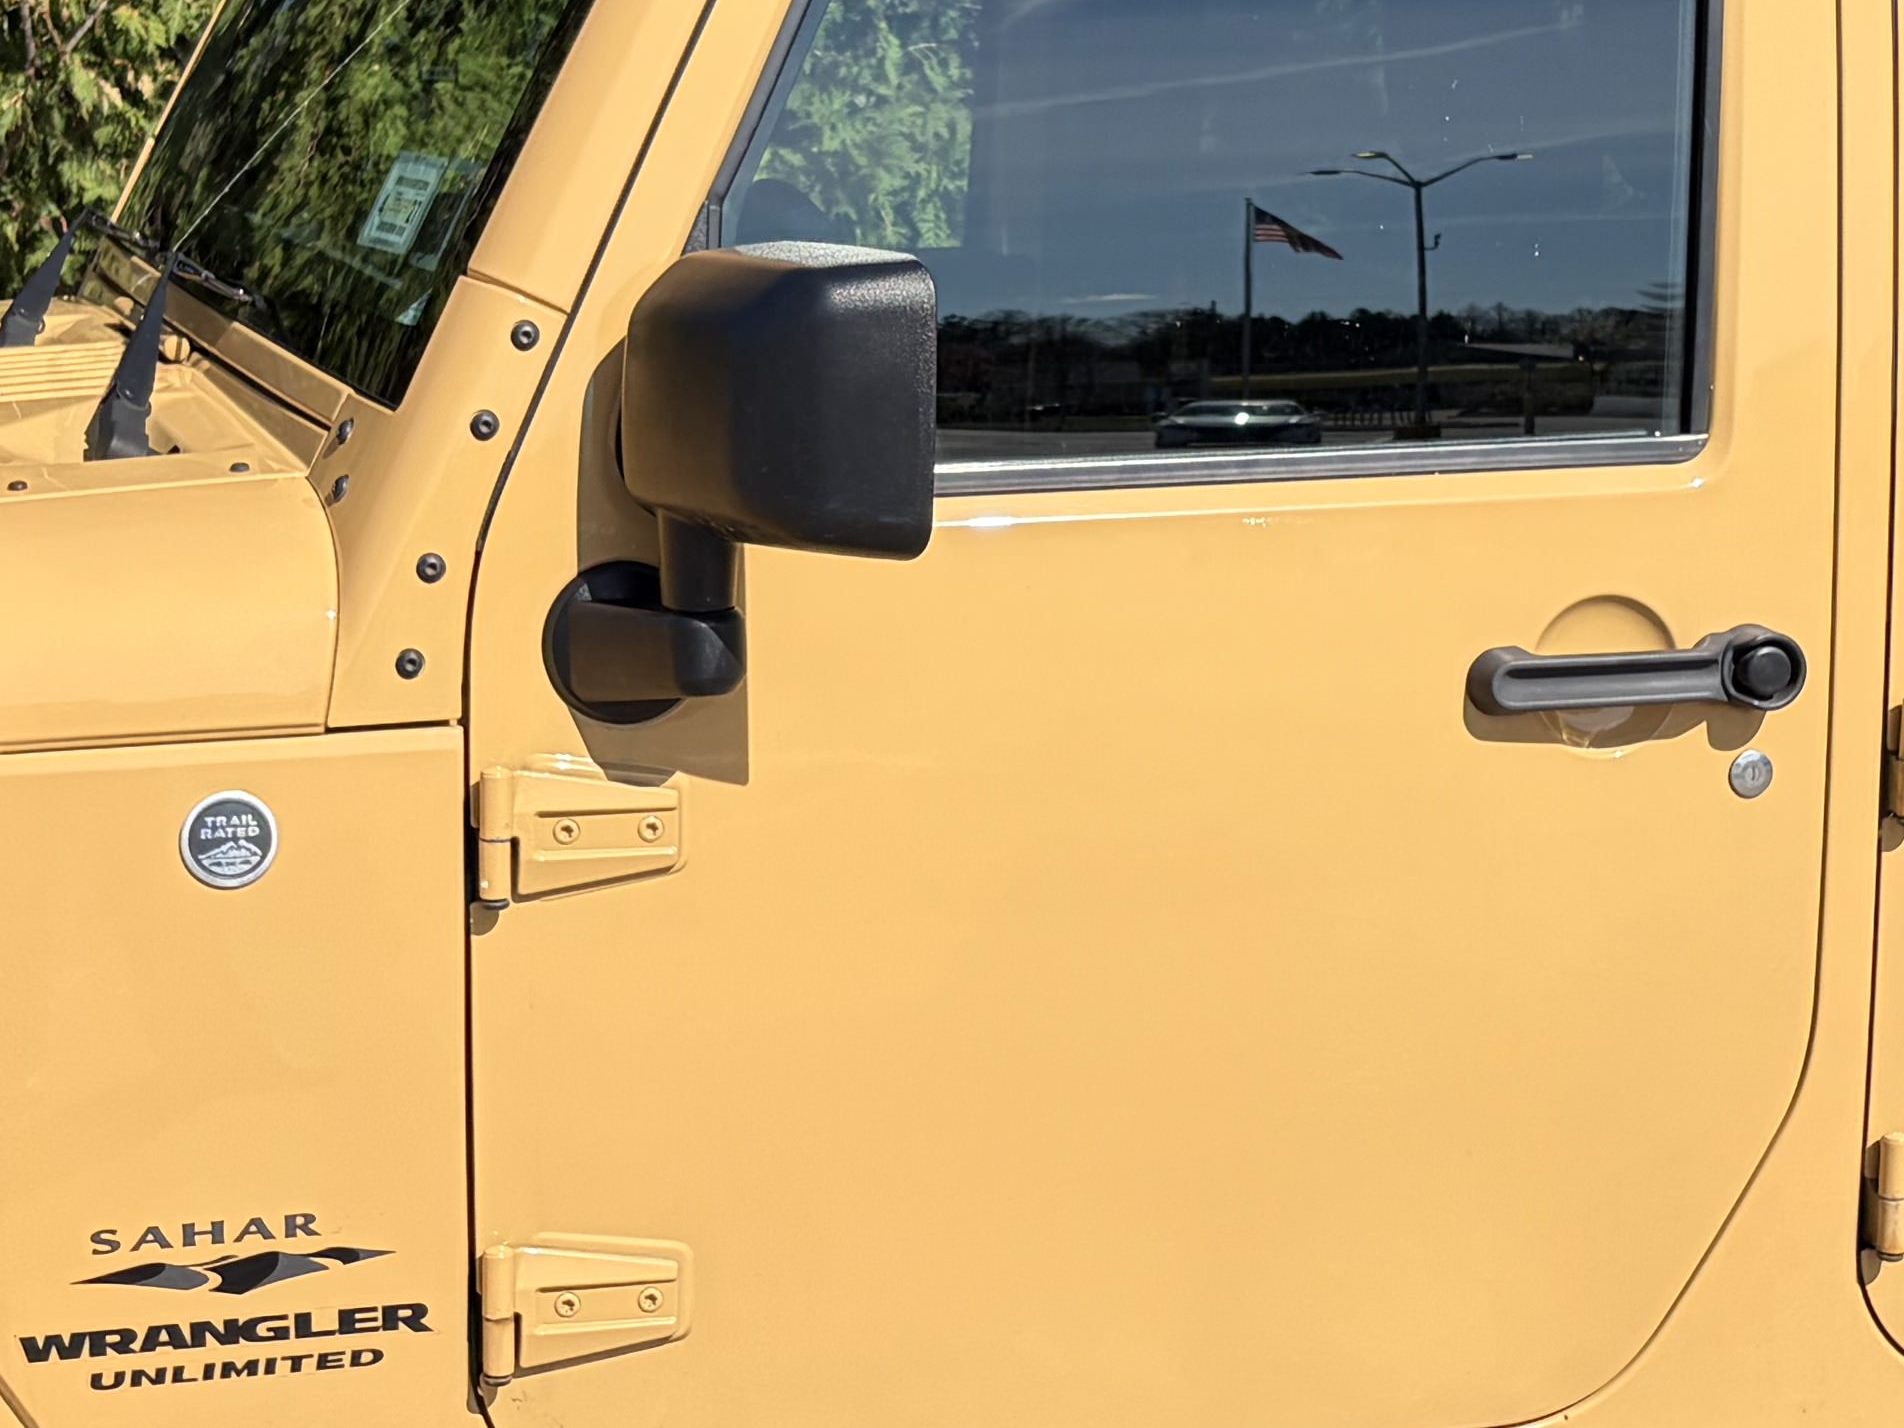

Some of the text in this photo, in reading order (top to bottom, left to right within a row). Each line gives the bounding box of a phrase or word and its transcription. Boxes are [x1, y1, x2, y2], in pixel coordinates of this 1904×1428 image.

[200, 826, 260, 840] RATED
[204, 814, 258, 826] TRAIL
[89, 1212, 322, 1256] SAHAR
[19, 1302, 433, 1364] WRANGLER
[88, 1348, 386, 1391] UNLIMITED
